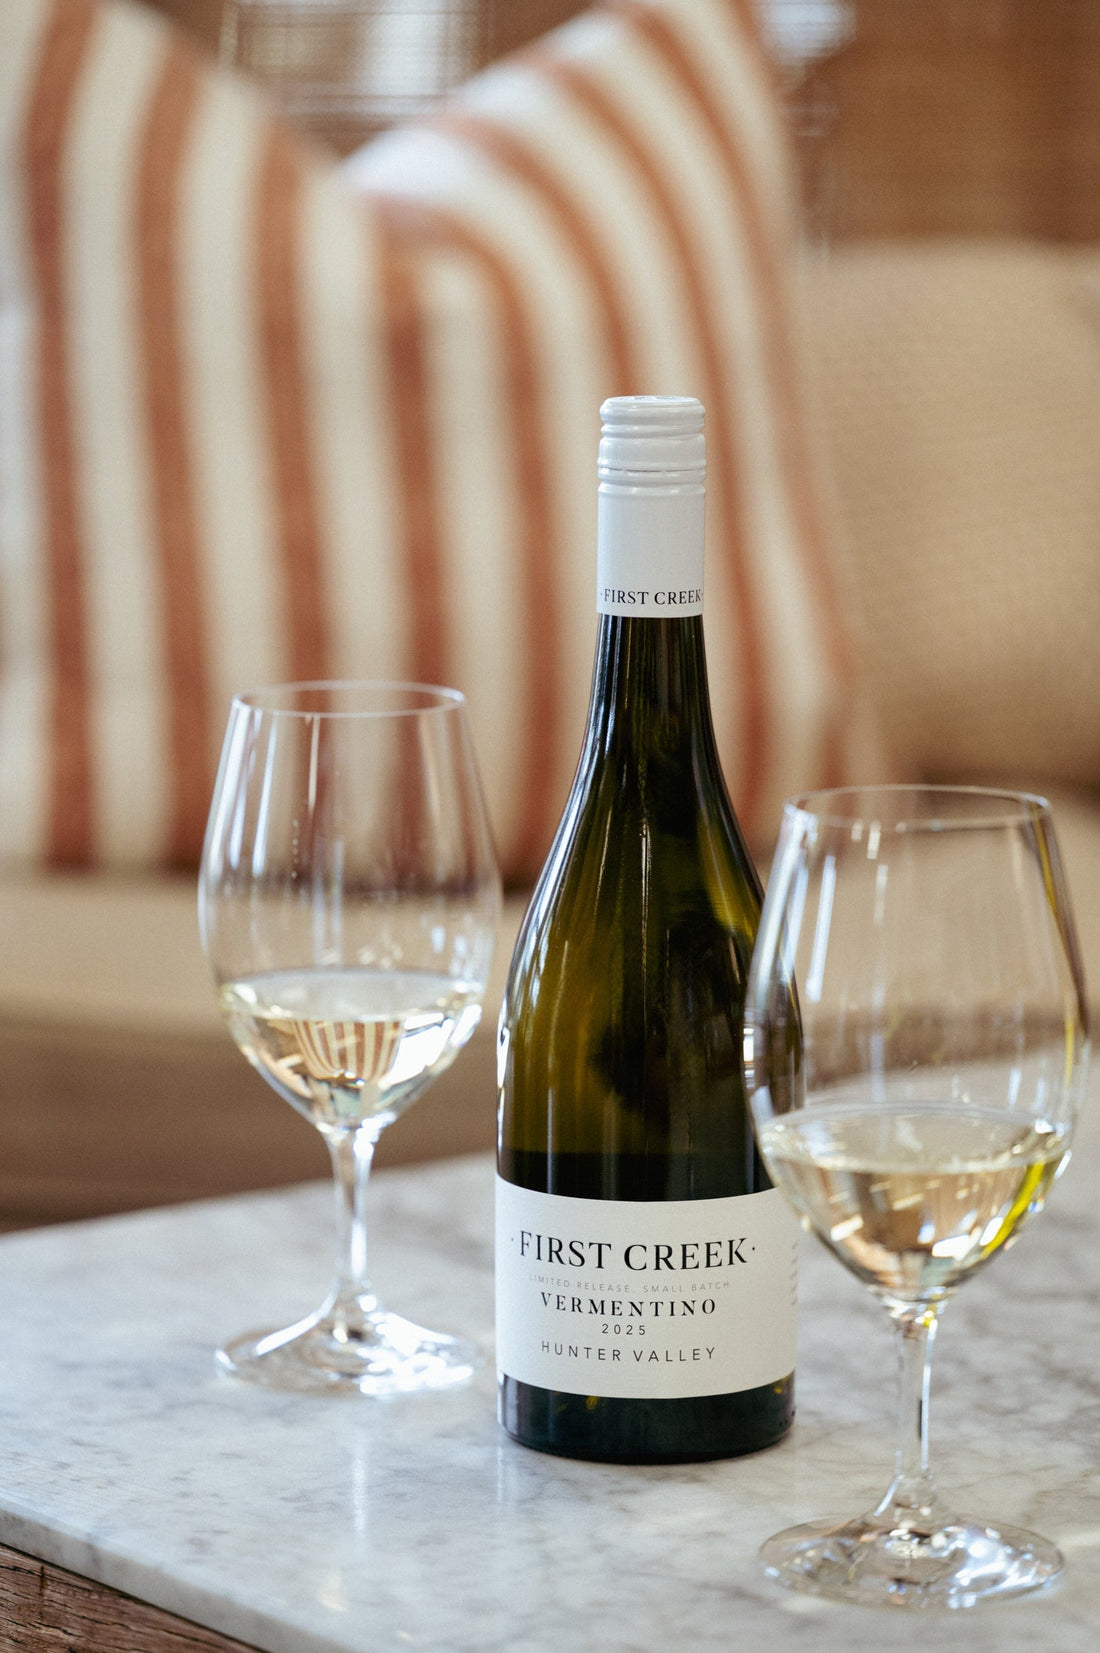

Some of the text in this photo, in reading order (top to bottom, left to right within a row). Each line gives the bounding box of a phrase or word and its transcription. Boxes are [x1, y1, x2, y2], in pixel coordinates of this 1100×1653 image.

[519, 1230, 748, 1271] FIRST CREEK
[530, 1274, 570, 1288] LIMITED
[643, 1284, 684, 1293] SMALL
[691, 1281, 730, 1292] BATCH
[541, 1291, 716, 1317] VERMENTINO
[601, 1323, 646, 1336] 2025
[541, 1340, 716, 1362] HUNTER VALLEY
